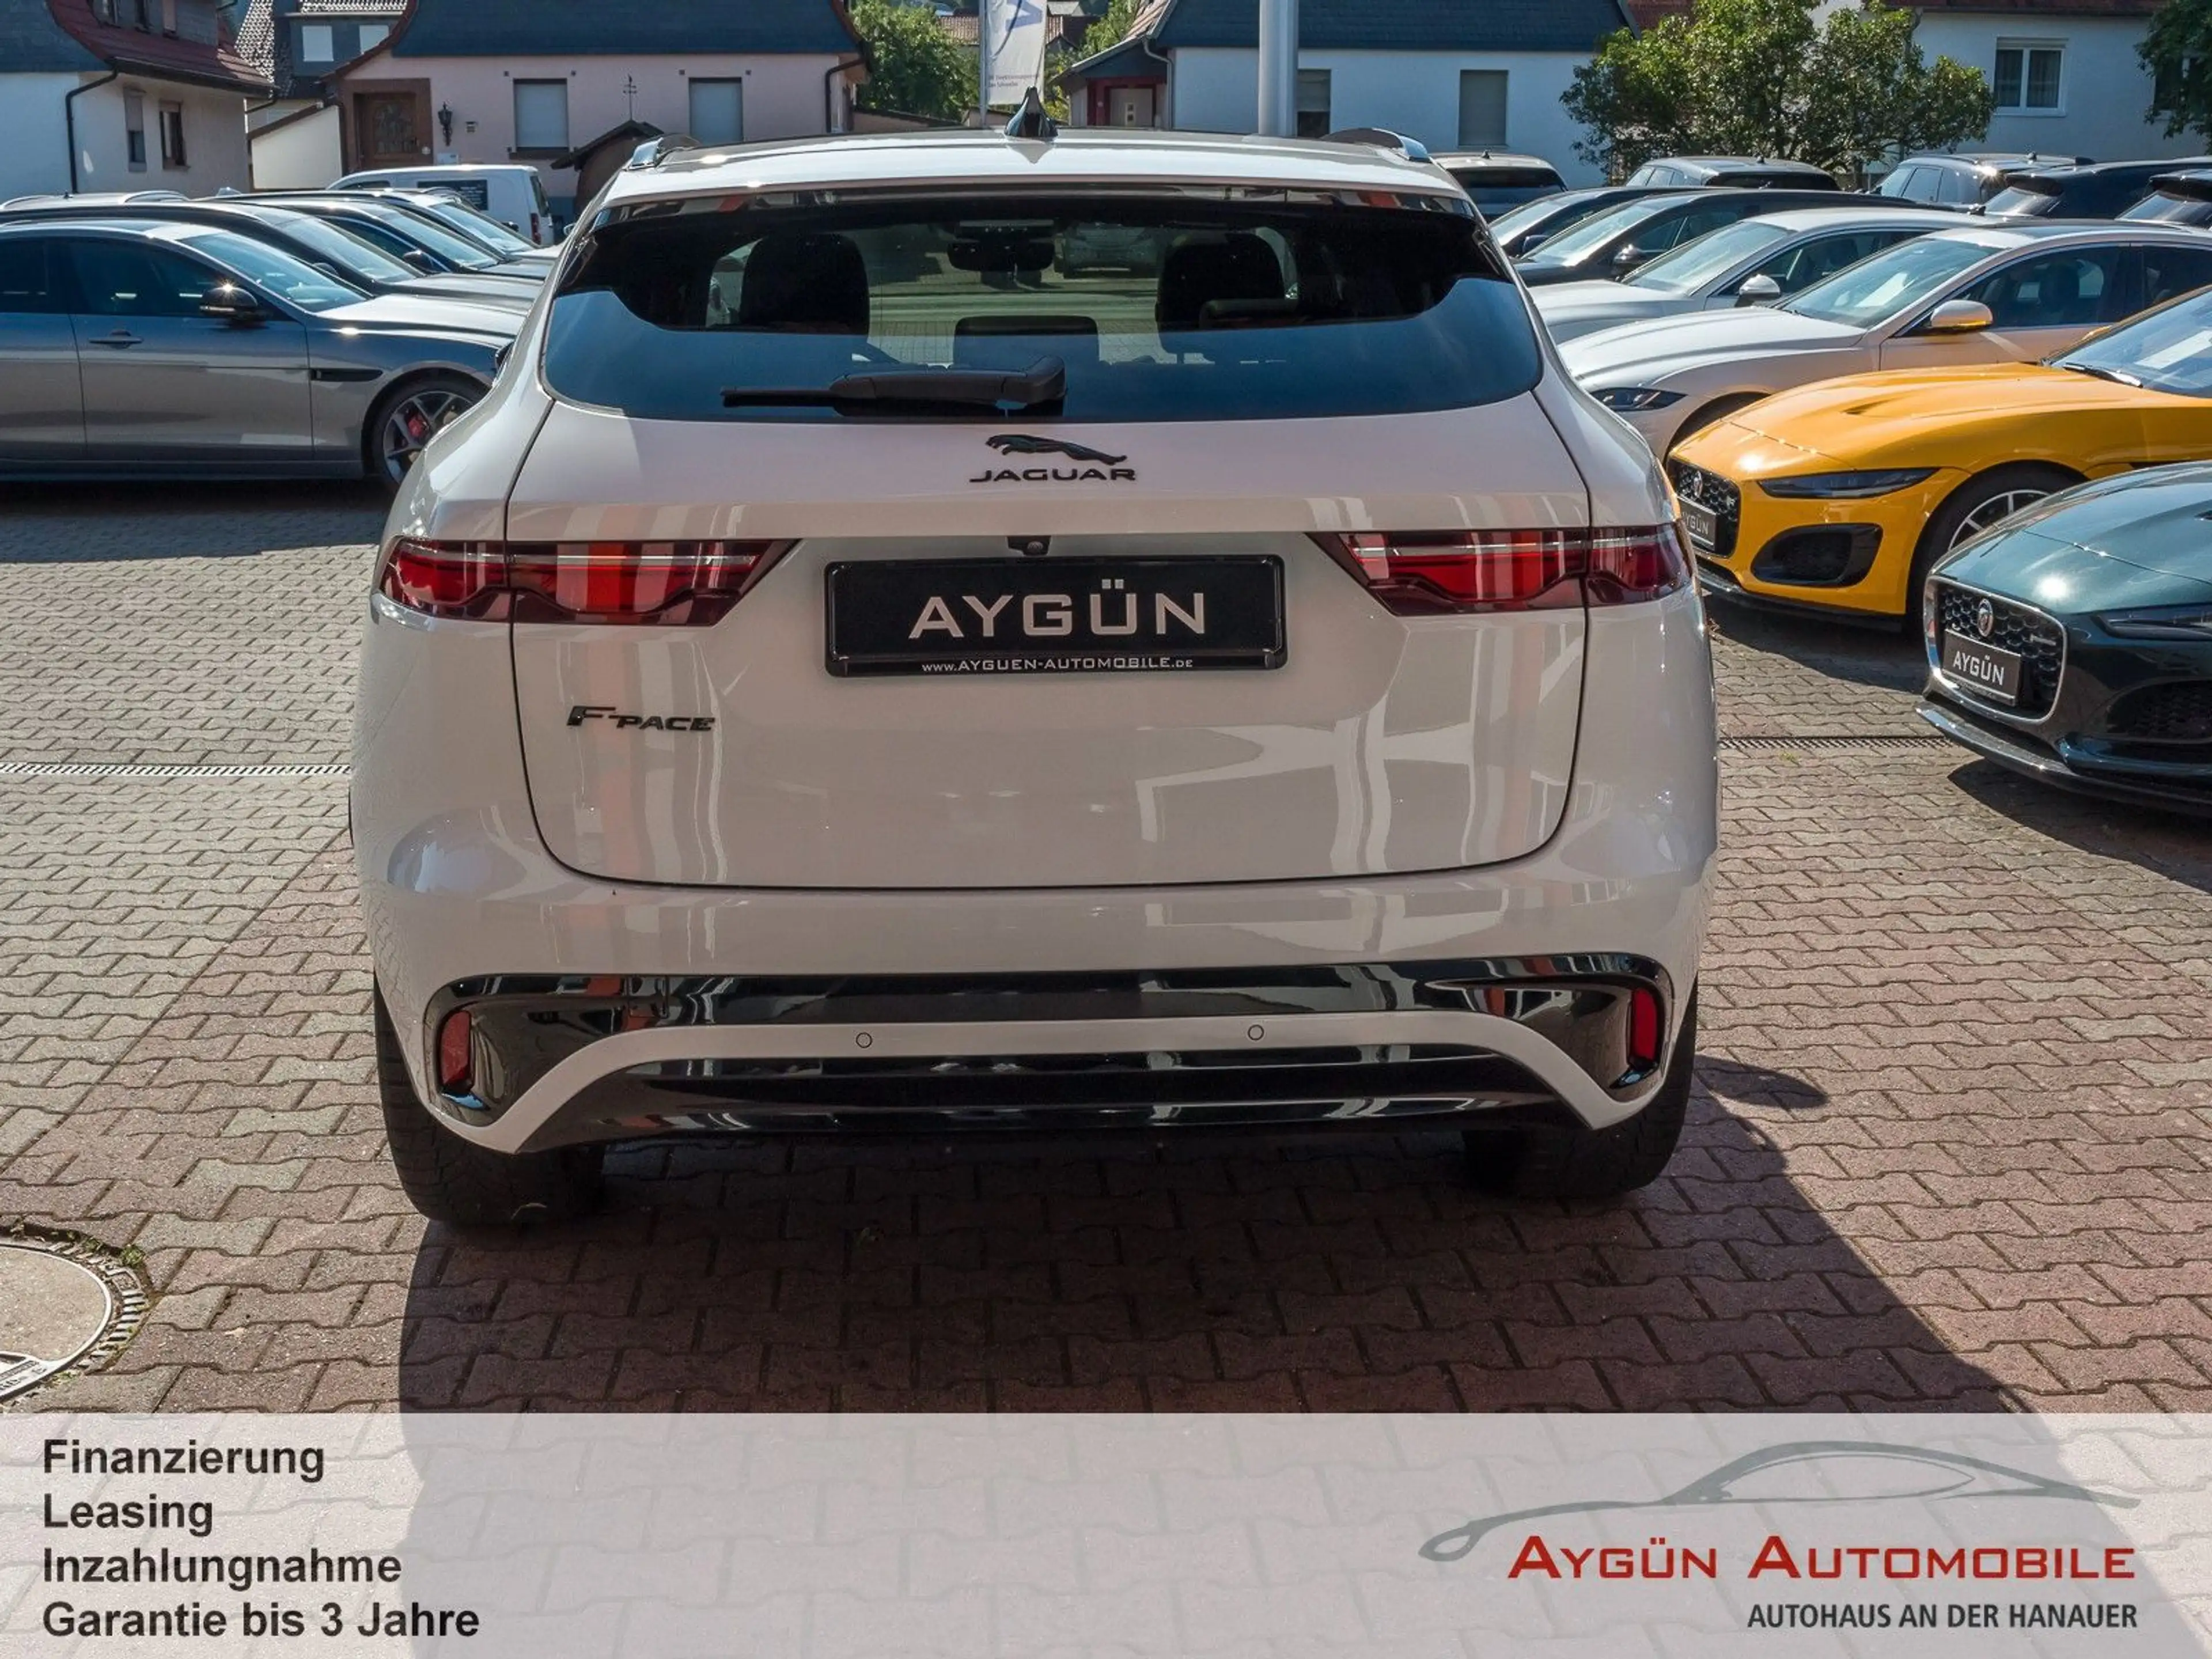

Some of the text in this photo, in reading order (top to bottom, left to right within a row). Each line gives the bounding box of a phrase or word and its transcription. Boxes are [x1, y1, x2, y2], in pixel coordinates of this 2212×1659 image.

[969, 467, 1137, 483] JAGUAR
[908, 578, 1206, 639] AYGÜN
[1952, 650, 2004, 685] AYGÜN
